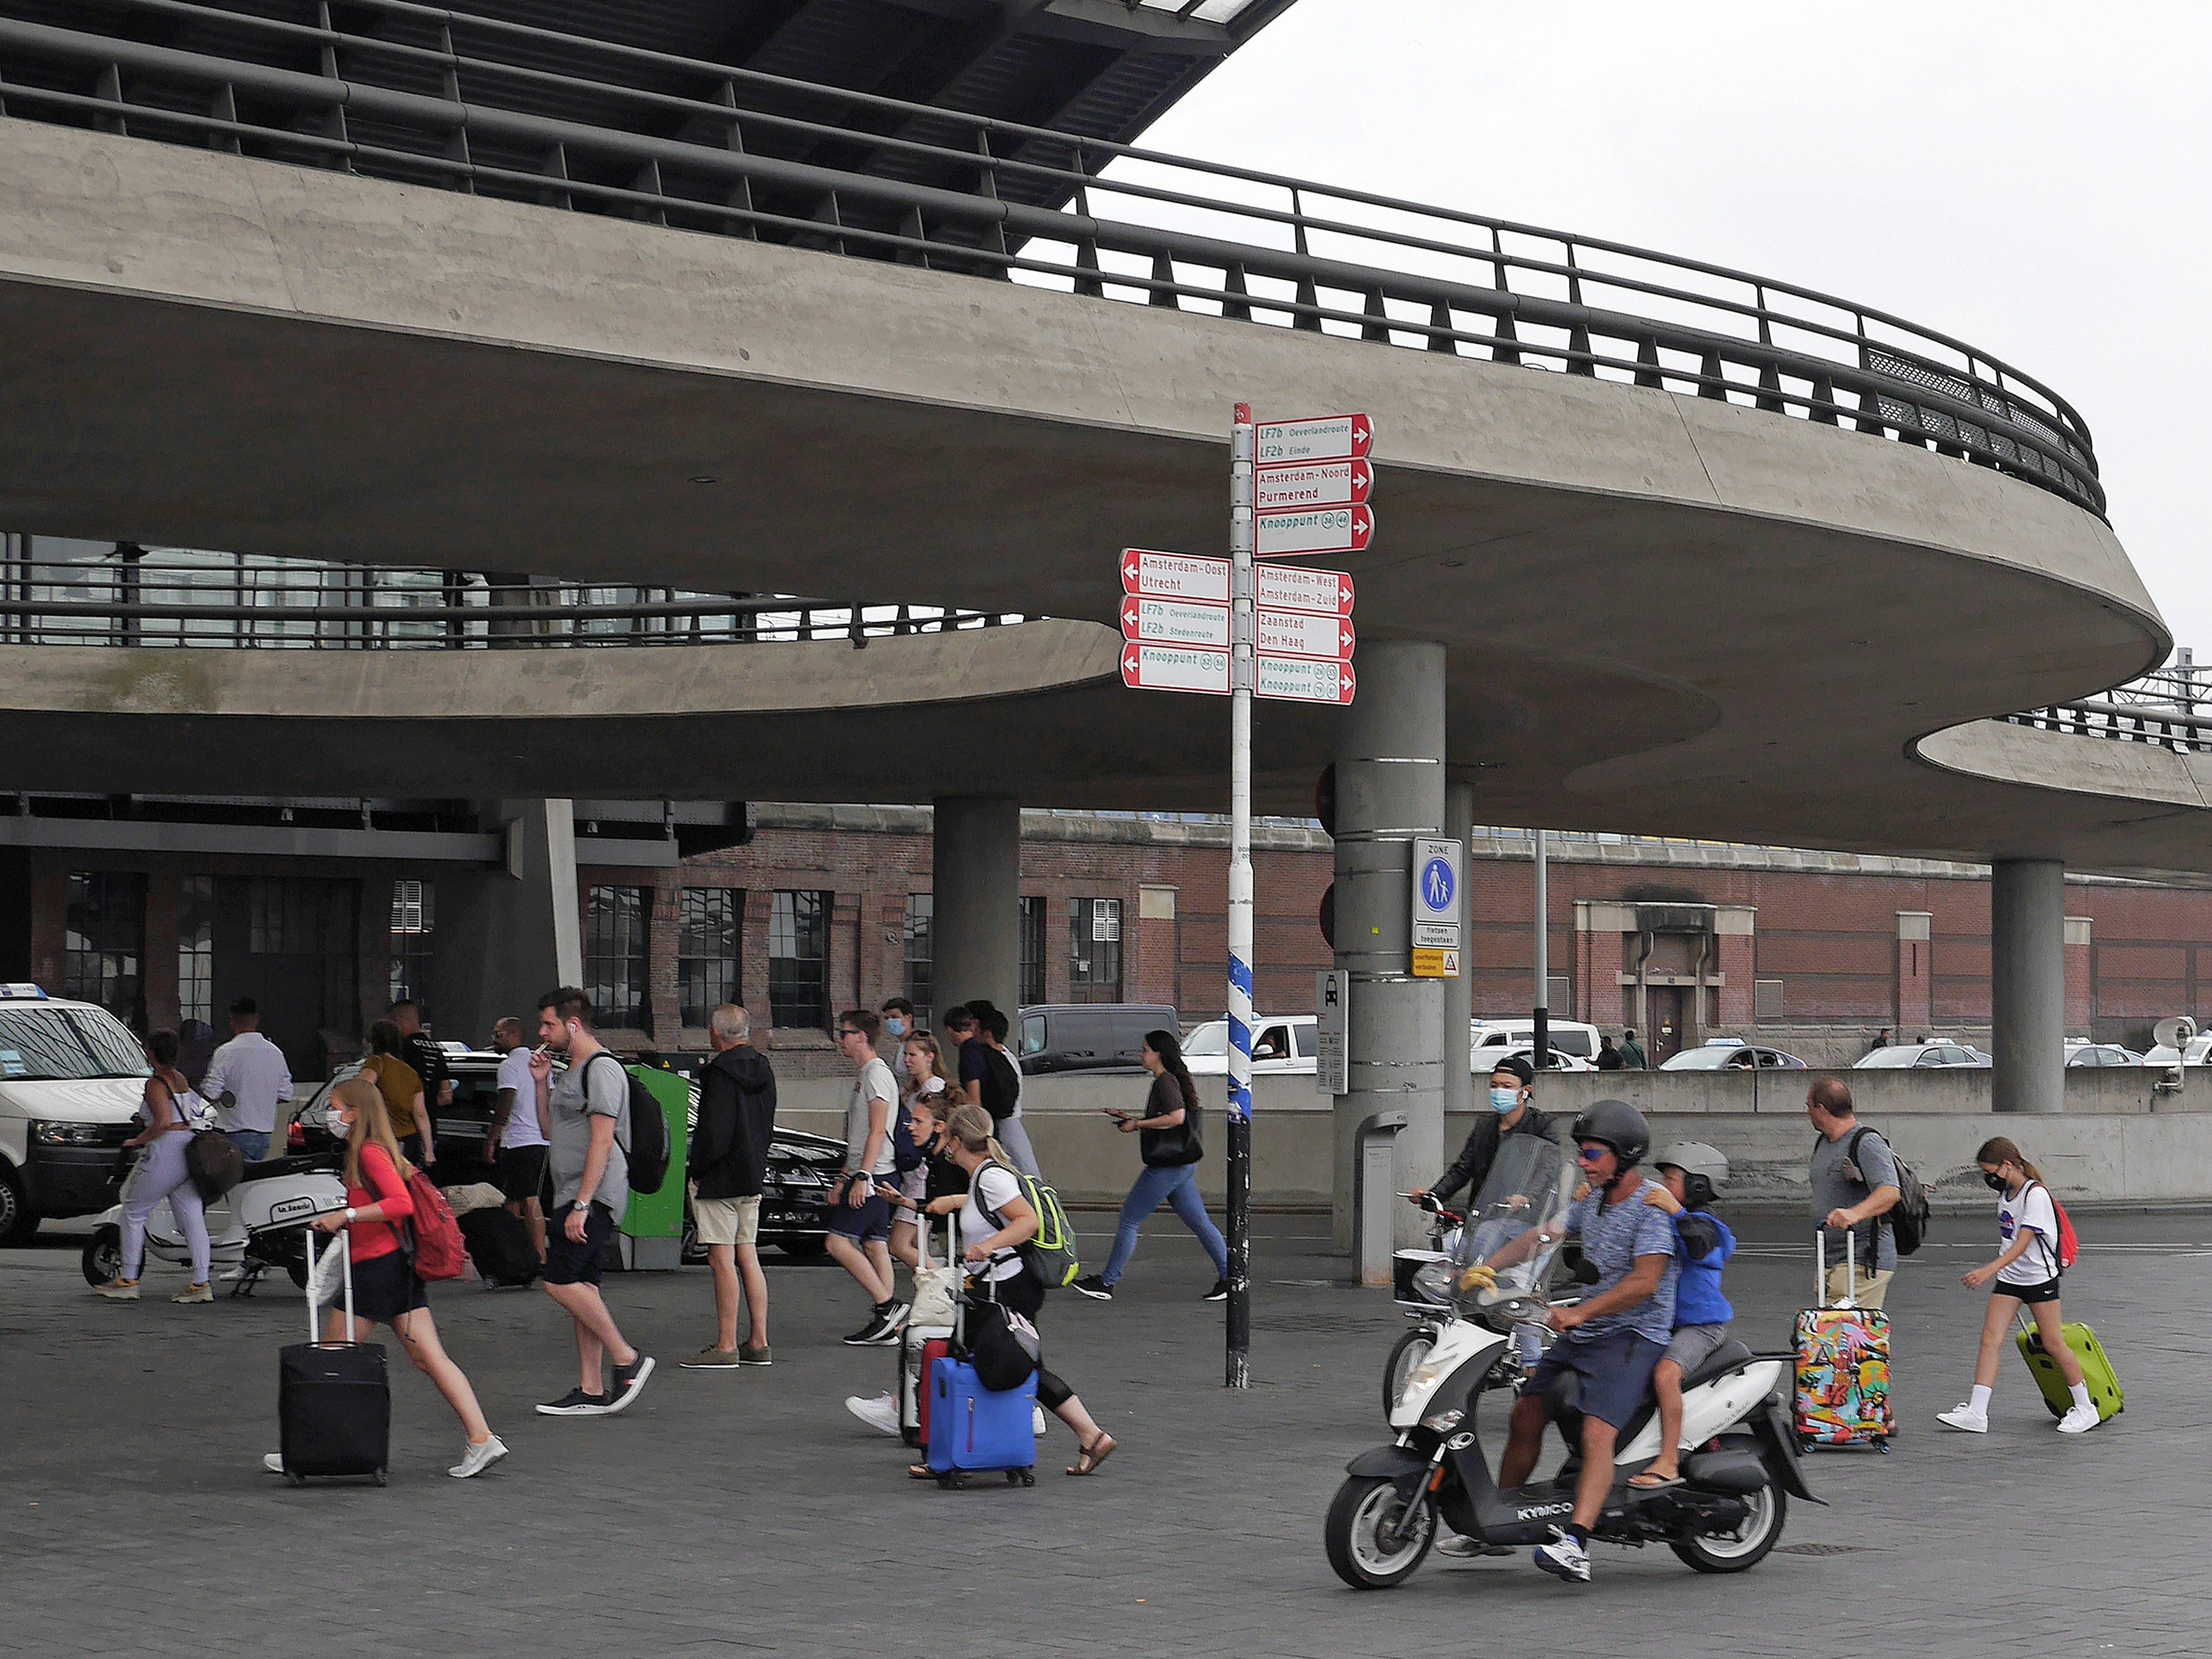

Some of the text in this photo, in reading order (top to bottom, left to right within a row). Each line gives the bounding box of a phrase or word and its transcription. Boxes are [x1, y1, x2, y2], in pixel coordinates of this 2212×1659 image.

[1260, 427, 1283, 439] LF7b
[1260, 445, 1310, 458] LF2b Einde
[1259, 467, 1349, 484] Amsterdam-Noord
[1259, 487, 1318, 502] Purmerend
[1260, 515, 1318, 529] Knooppunt
[1142, 557, 1227, 576] Amsterdam-Oost
[1142, 575, 1181, 590] Utrecht
[1260, 569, 1337, 588] Amsterdam-West
[1260, 588, 1337, 606] Amsterdam-Zuid
[1142, 603, 1163, 616] LF7b
[1142, 621, 1164, 634] LF2b
[1260, 614, 1304, 629] Zaanstad
[1260, 633, 1304, 650] Den Haag
[1142, 649, 1197, 664] Knooppunt
[1260, 659, 1311, 674] Knooppunt
[1260, 678, 1311, 692] Knooppunt
[1428, 844, 1449, 854] ZONE
[1517, 1502, 1575, 1520] KYMCO
